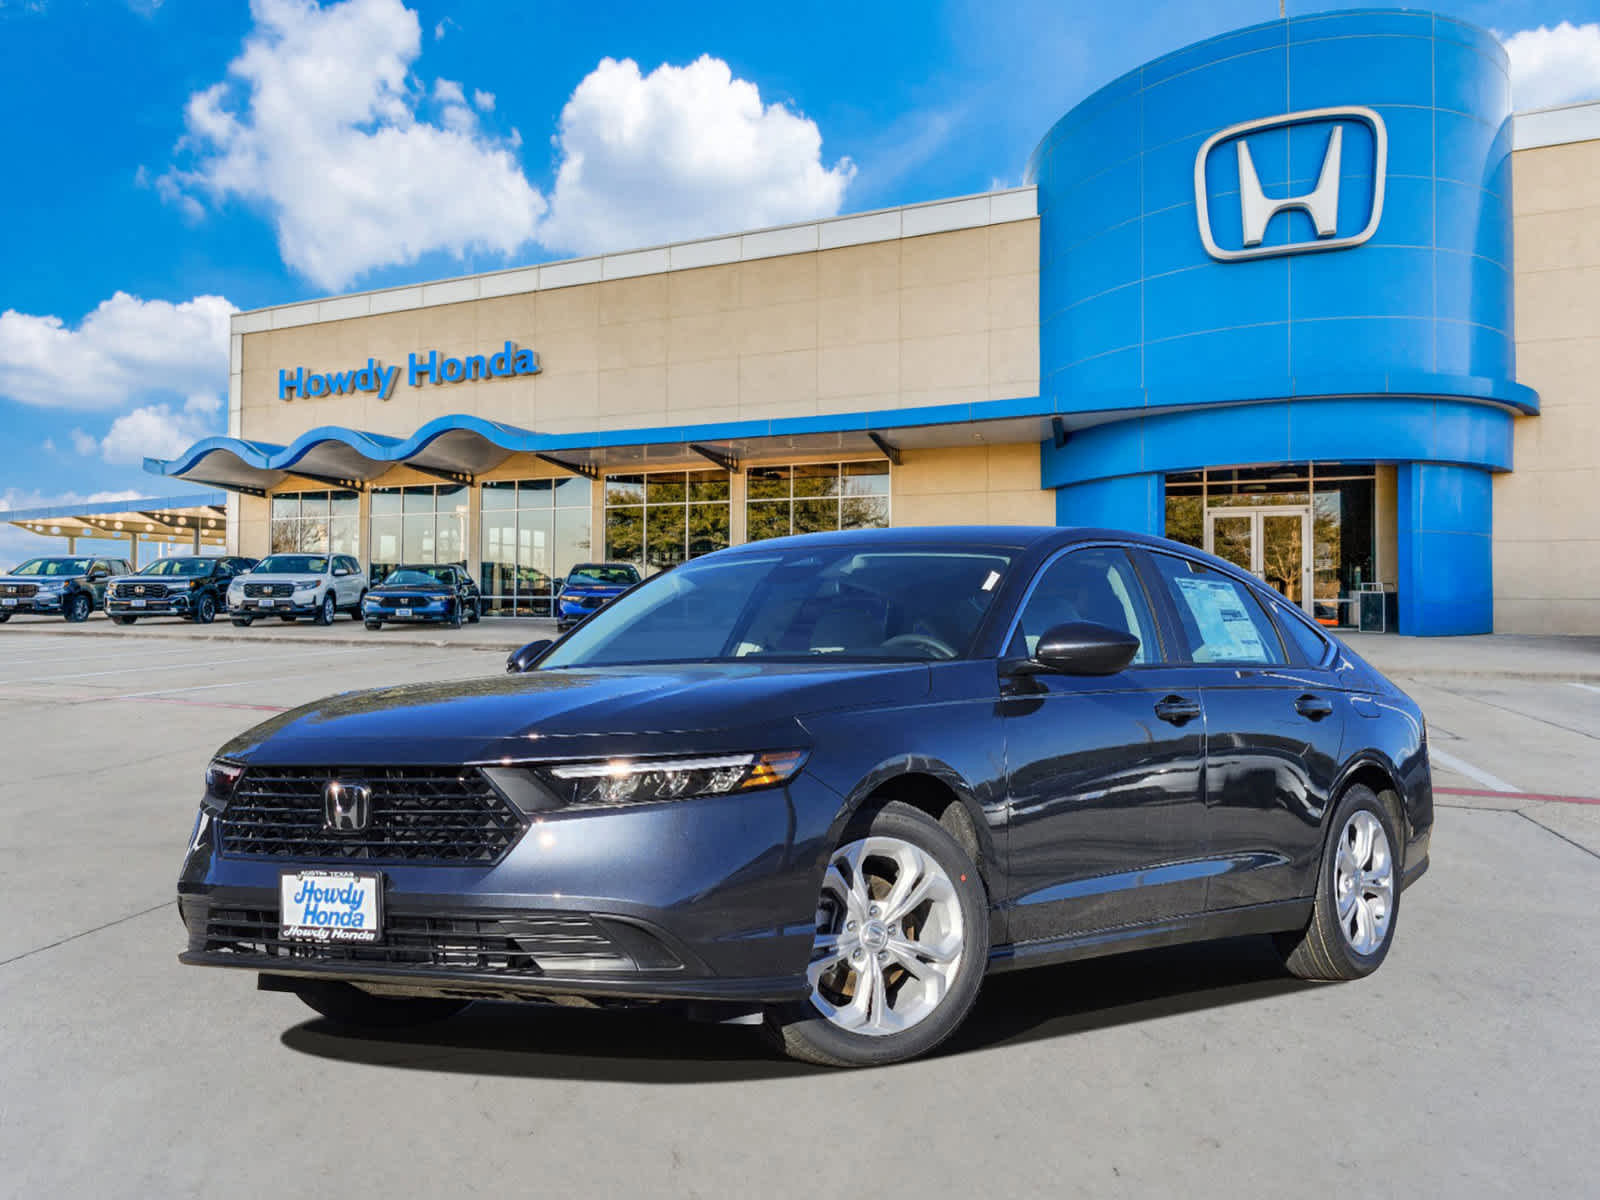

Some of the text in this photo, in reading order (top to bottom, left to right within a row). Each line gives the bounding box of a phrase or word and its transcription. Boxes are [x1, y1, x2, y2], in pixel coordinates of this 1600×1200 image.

[278, 340, 543, 401] Howdy Honda
[294, 880, 364, 911] Howdy
[302, 903, 364, 928] Honda
[283, 926, 375, 941] Howdy Honda
